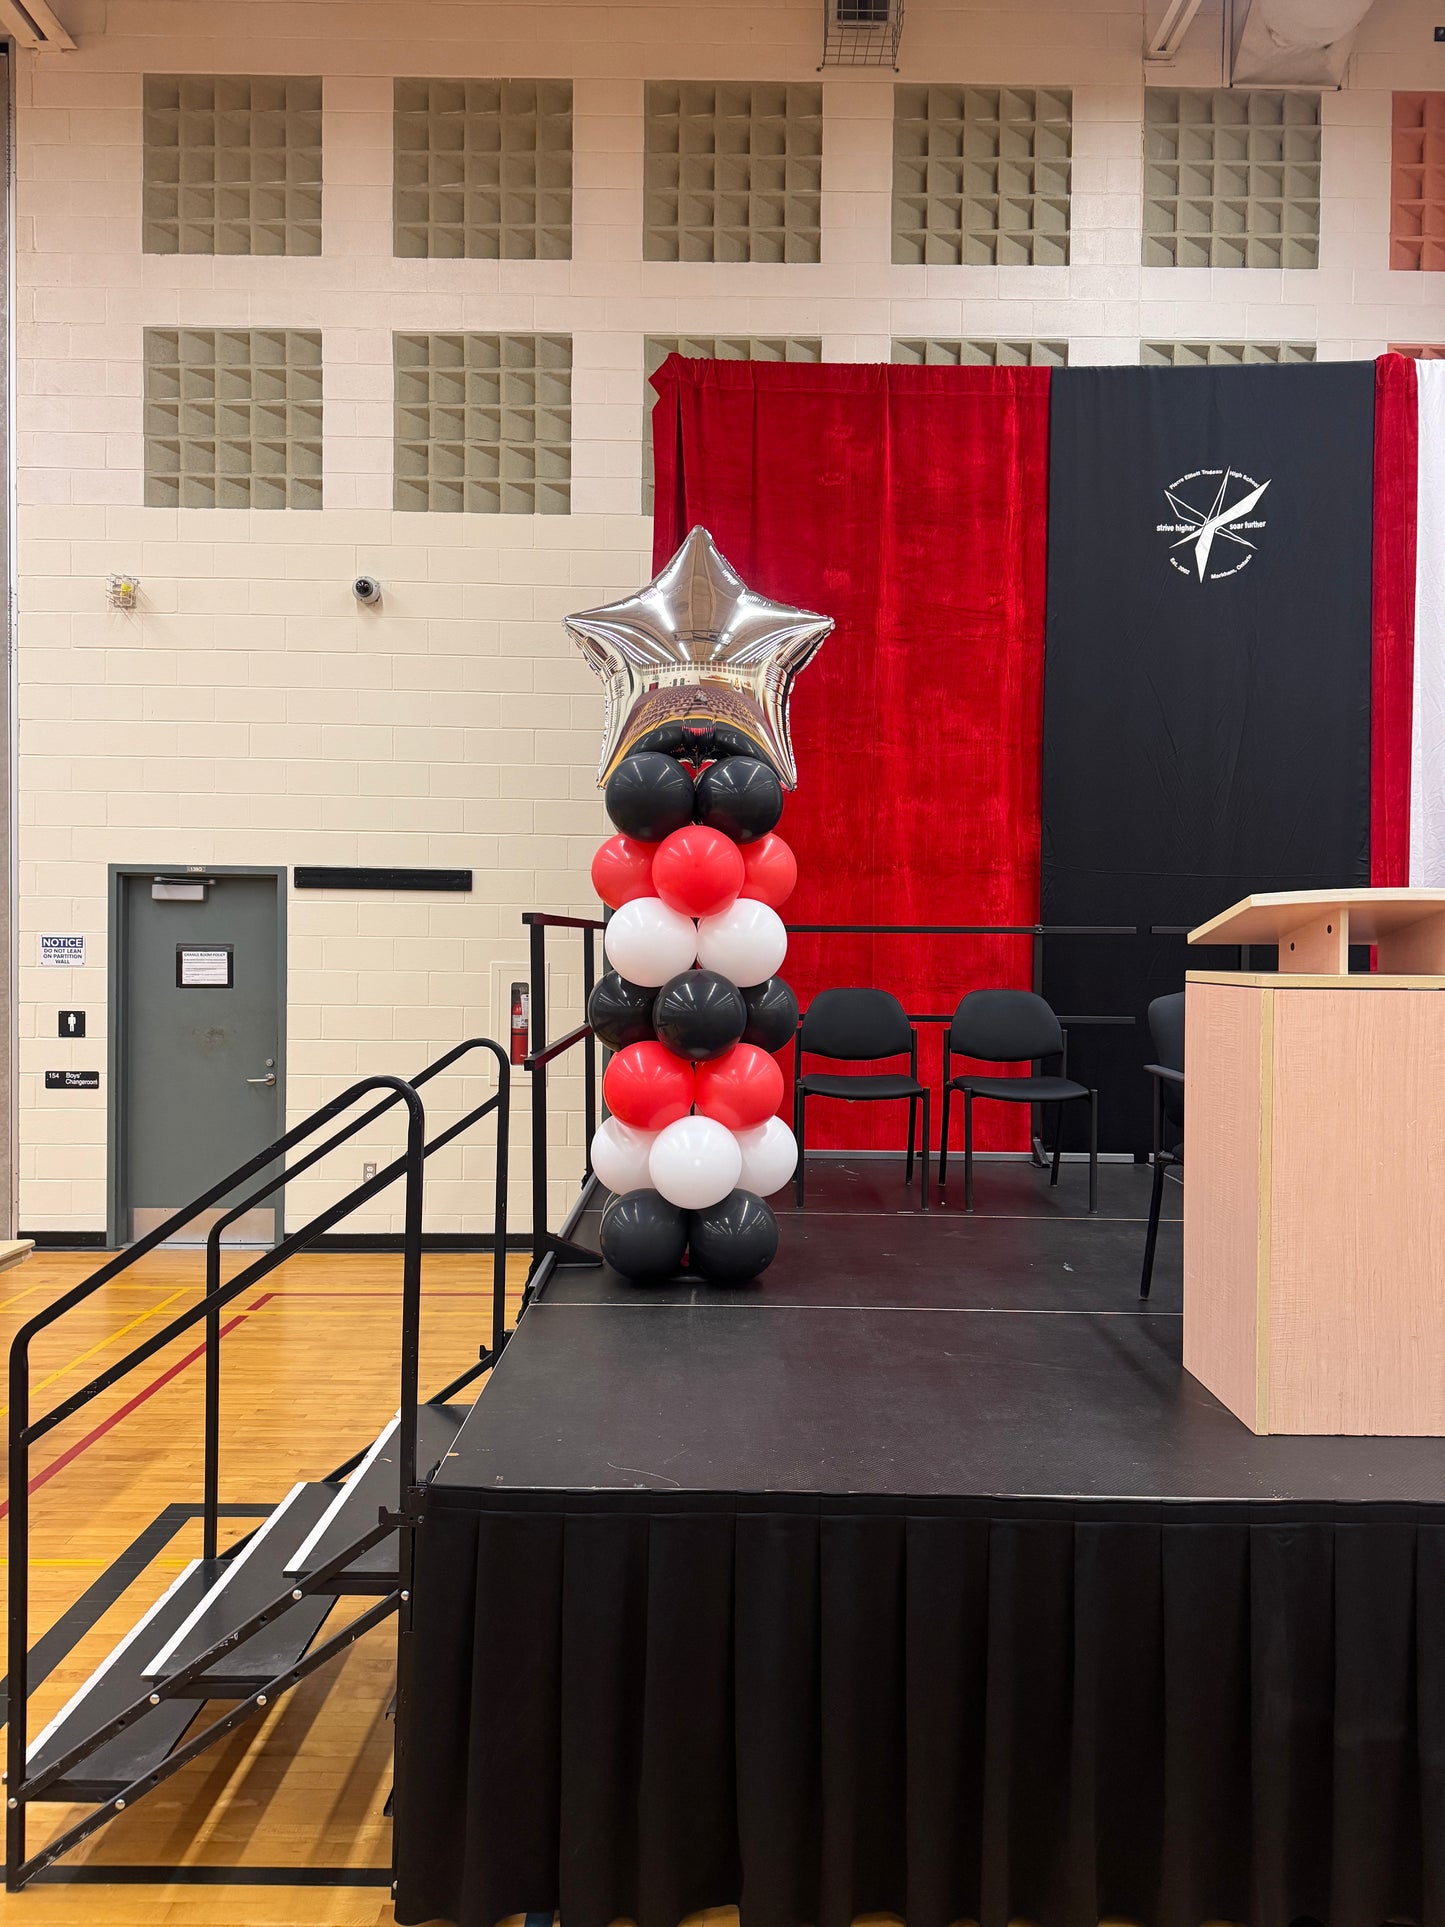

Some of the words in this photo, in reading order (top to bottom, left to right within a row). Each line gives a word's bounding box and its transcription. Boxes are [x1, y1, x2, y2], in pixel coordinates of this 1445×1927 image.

[1229, 470, 1243, 479] High
[1156, 523, 1174, 532] strive
[1175, 523, 1196, 534] higher
[1229, 522, 1244, 530] soar
[1244, 521, 1267, 529] further
[42, 938, 83, 947] NOTICE
[65, 1078, 98, 1086] Changeroom
